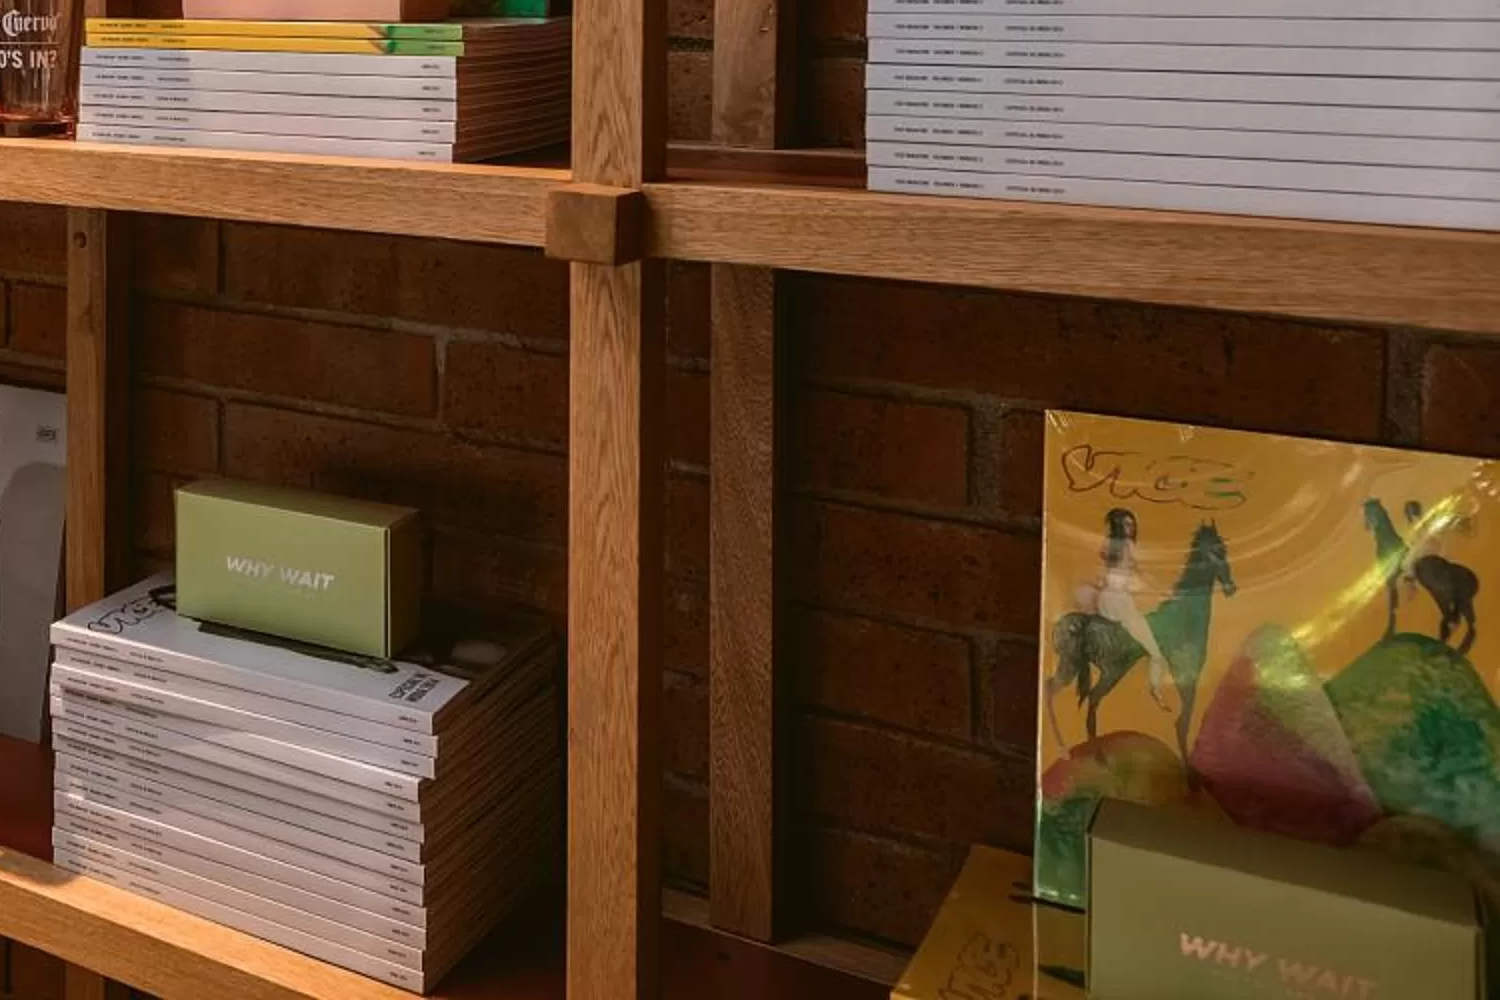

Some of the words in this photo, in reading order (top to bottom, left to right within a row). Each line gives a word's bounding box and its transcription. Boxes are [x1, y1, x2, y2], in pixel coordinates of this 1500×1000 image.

[29, 49, 57, 69] IN?
[226, 554, 275, 578] WHY
[280, 566, 336, 590] WAIT
[1180, 931, 1270, 971] WHY
